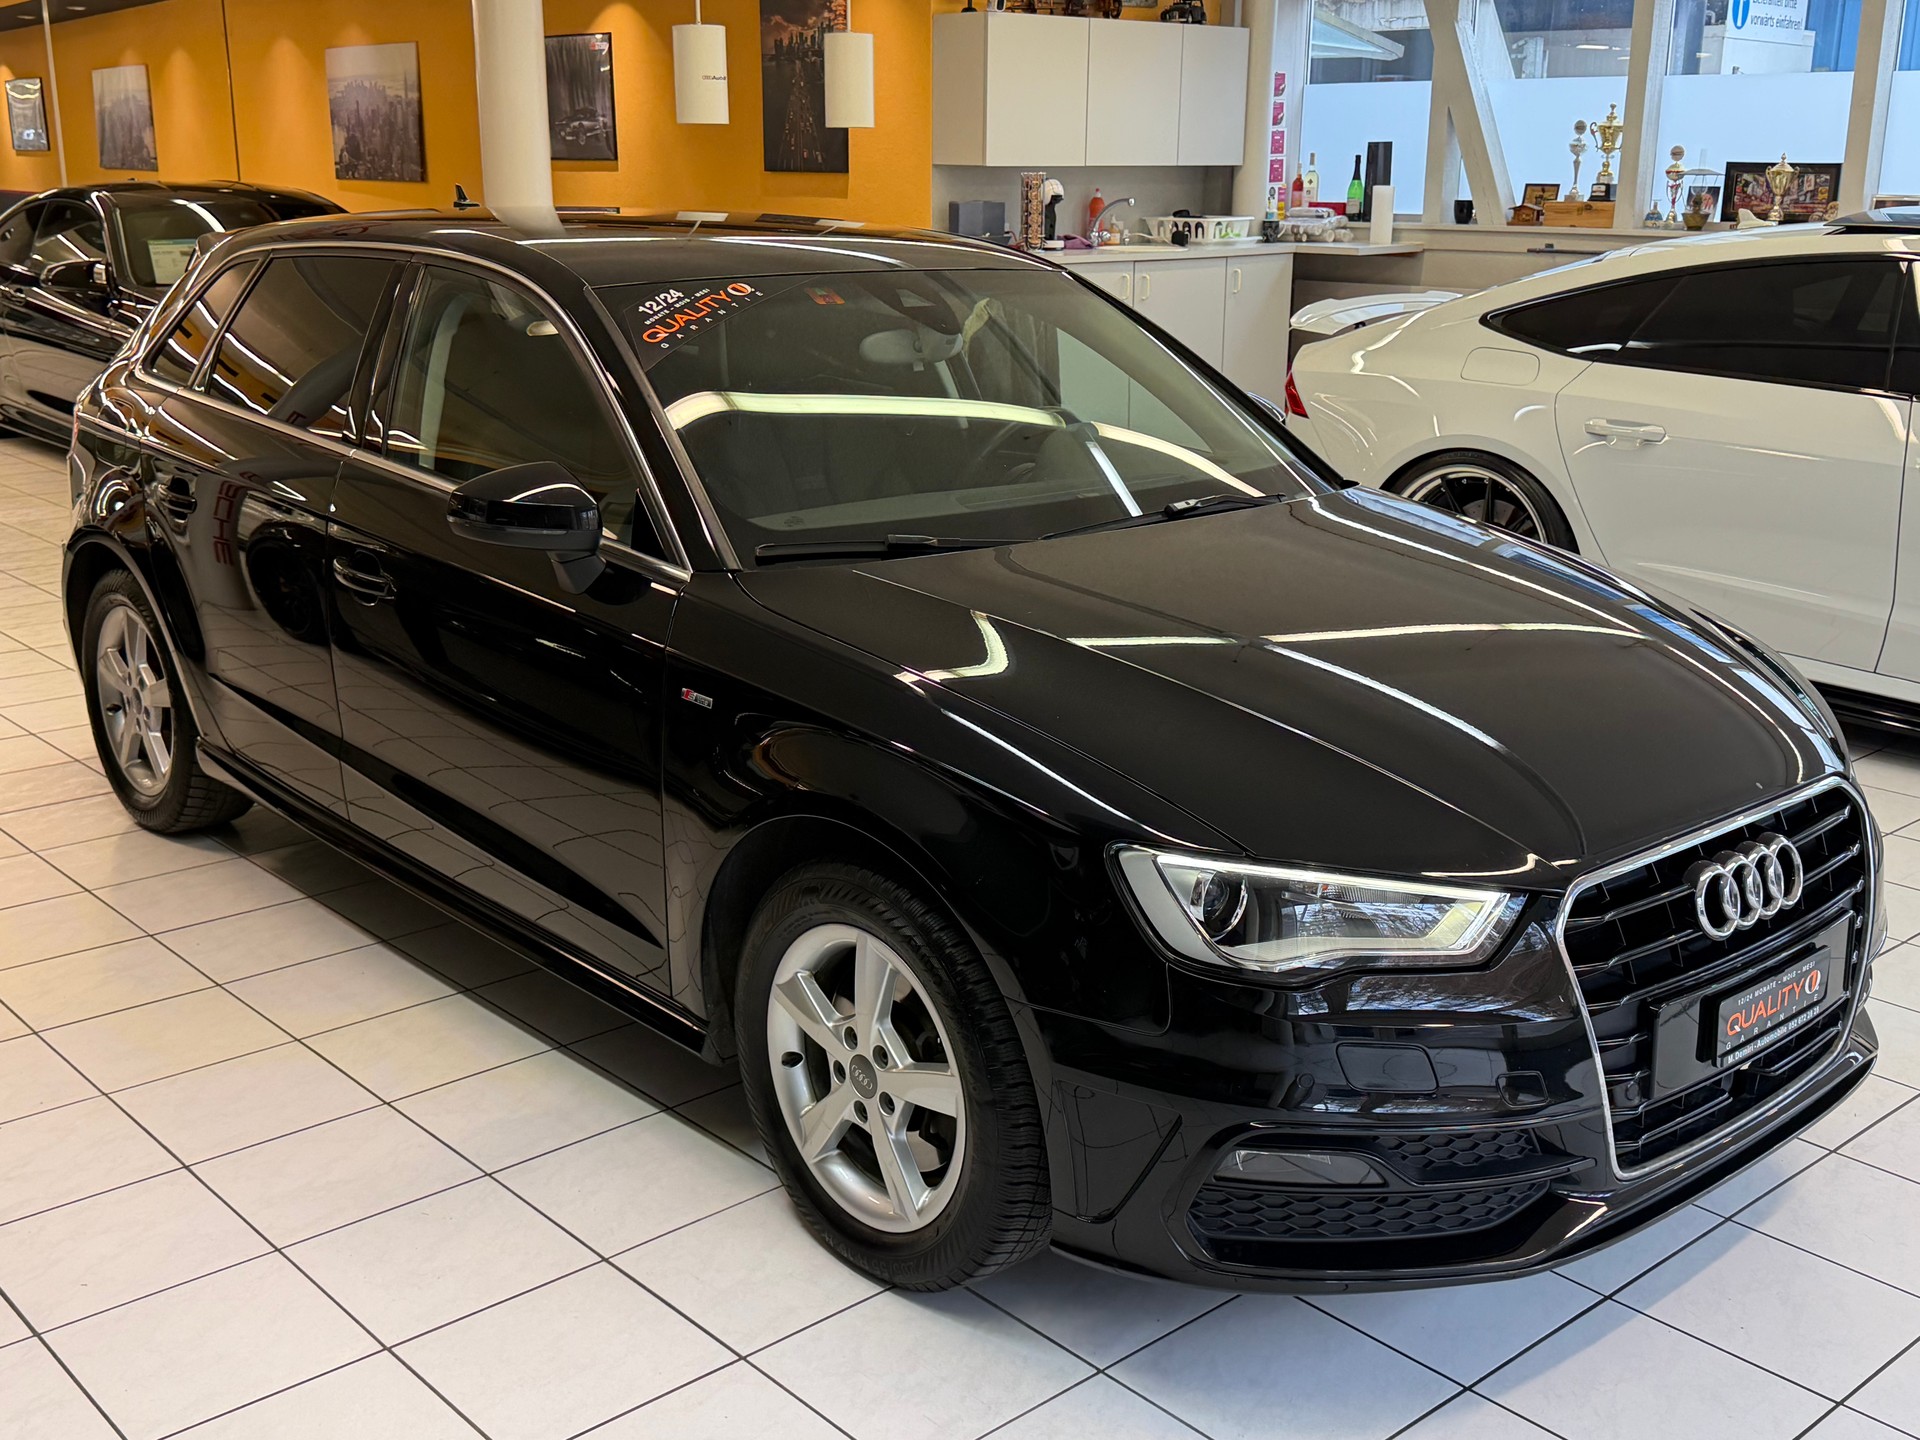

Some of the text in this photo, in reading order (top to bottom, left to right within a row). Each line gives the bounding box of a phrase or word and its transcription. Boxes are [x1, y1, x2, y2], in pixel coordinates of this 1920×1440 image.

[638, 289, 684, 315] 12/24
[644, 309, 670, 325] MONATE
[674, 298, 691, 309] MOIS
[694, 287, 711, 298] MESI
[1754, 980, 1777, 998] MONATE
[1783, 970, 1797, 983] MOIS
